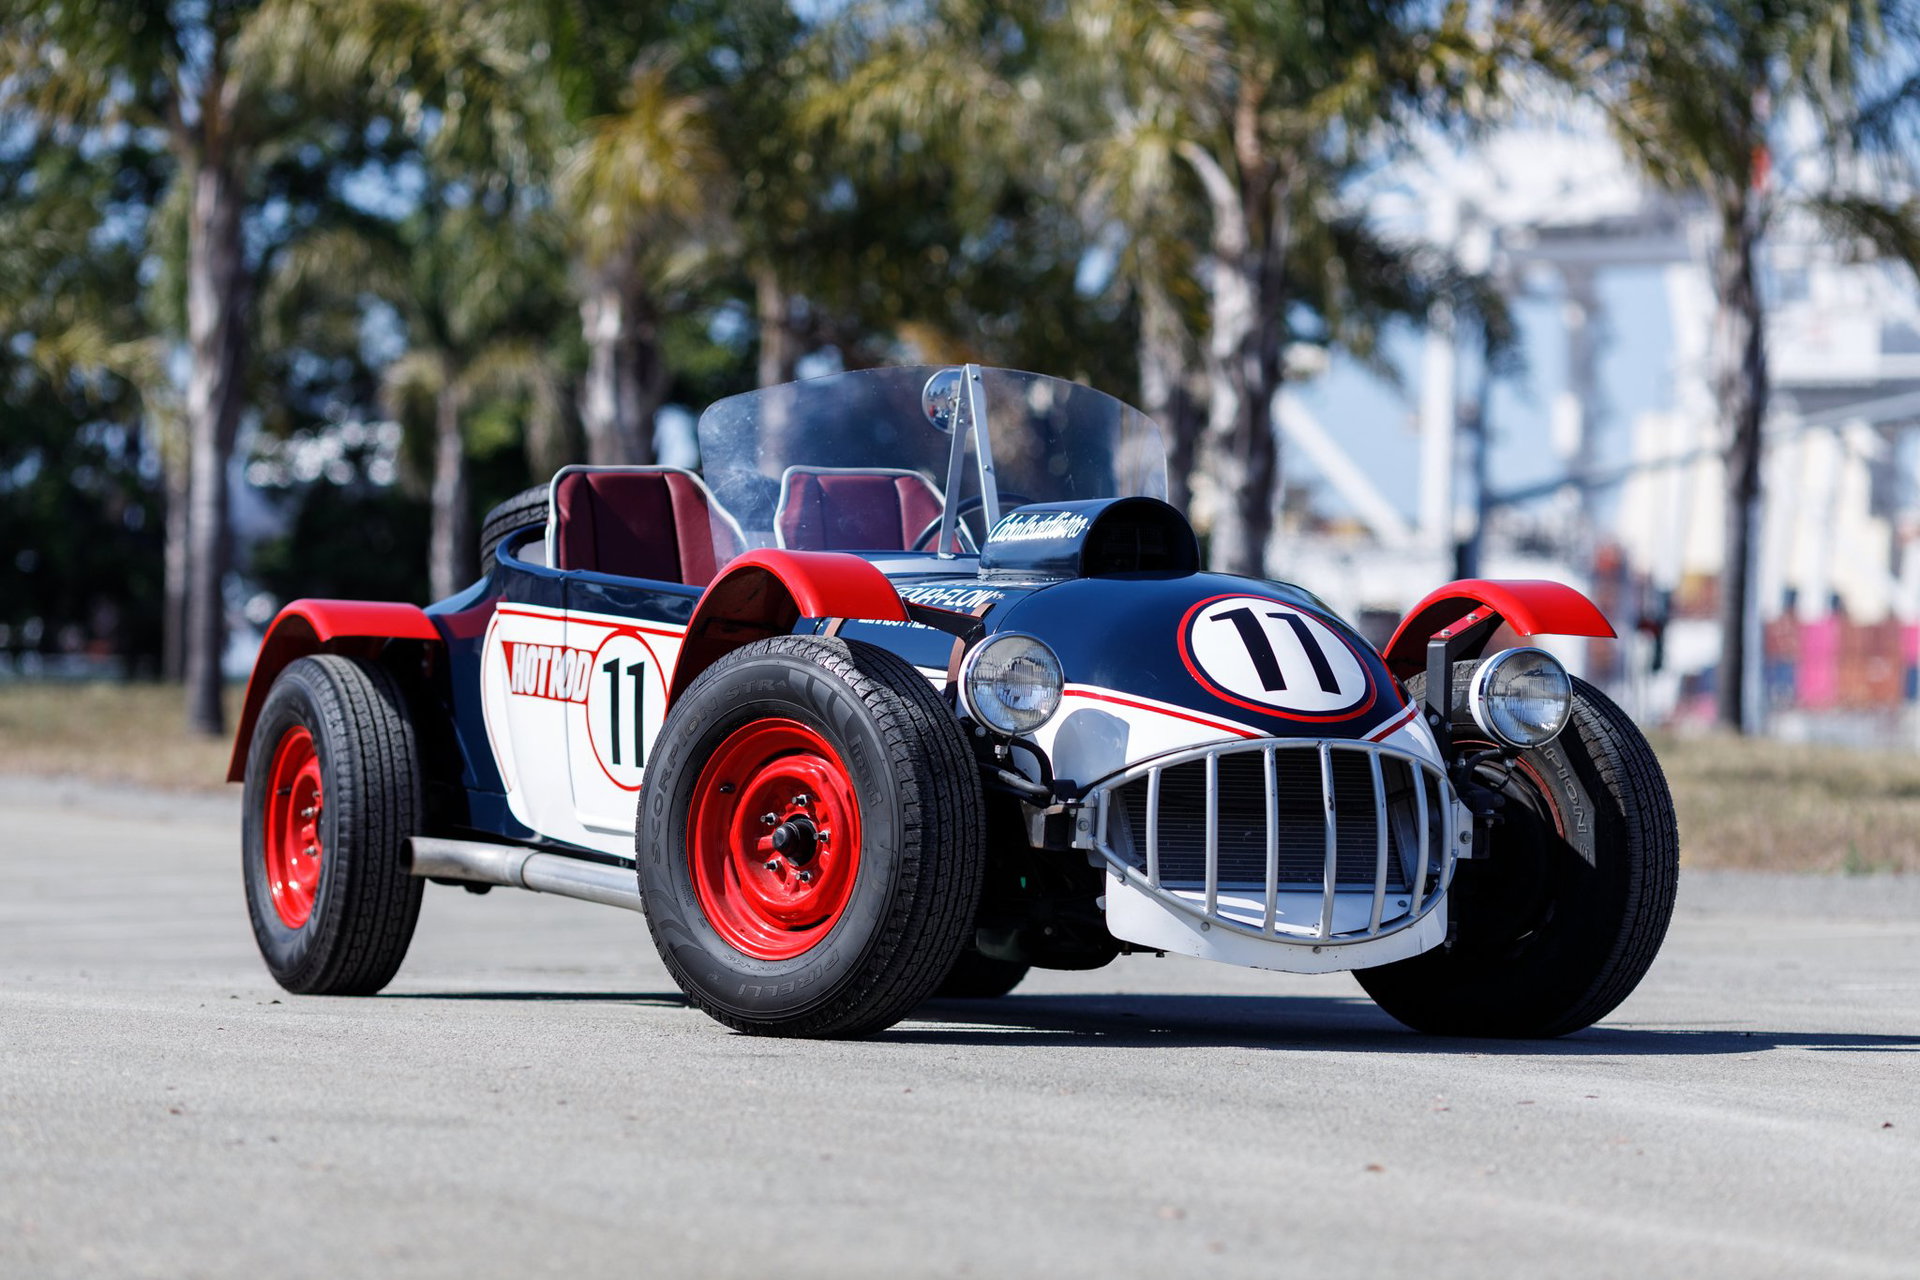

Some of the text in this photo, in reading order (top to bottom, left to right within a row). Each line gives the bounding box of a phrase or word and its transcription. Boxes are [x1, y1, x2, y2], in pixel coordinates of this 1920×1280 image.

[1209, 607, 1342, 695] 11
[603, 657, 645, 768] 11
[651, 702, 720, 865] SCORPION
[737, 949, 840, 997] PIRELLI
